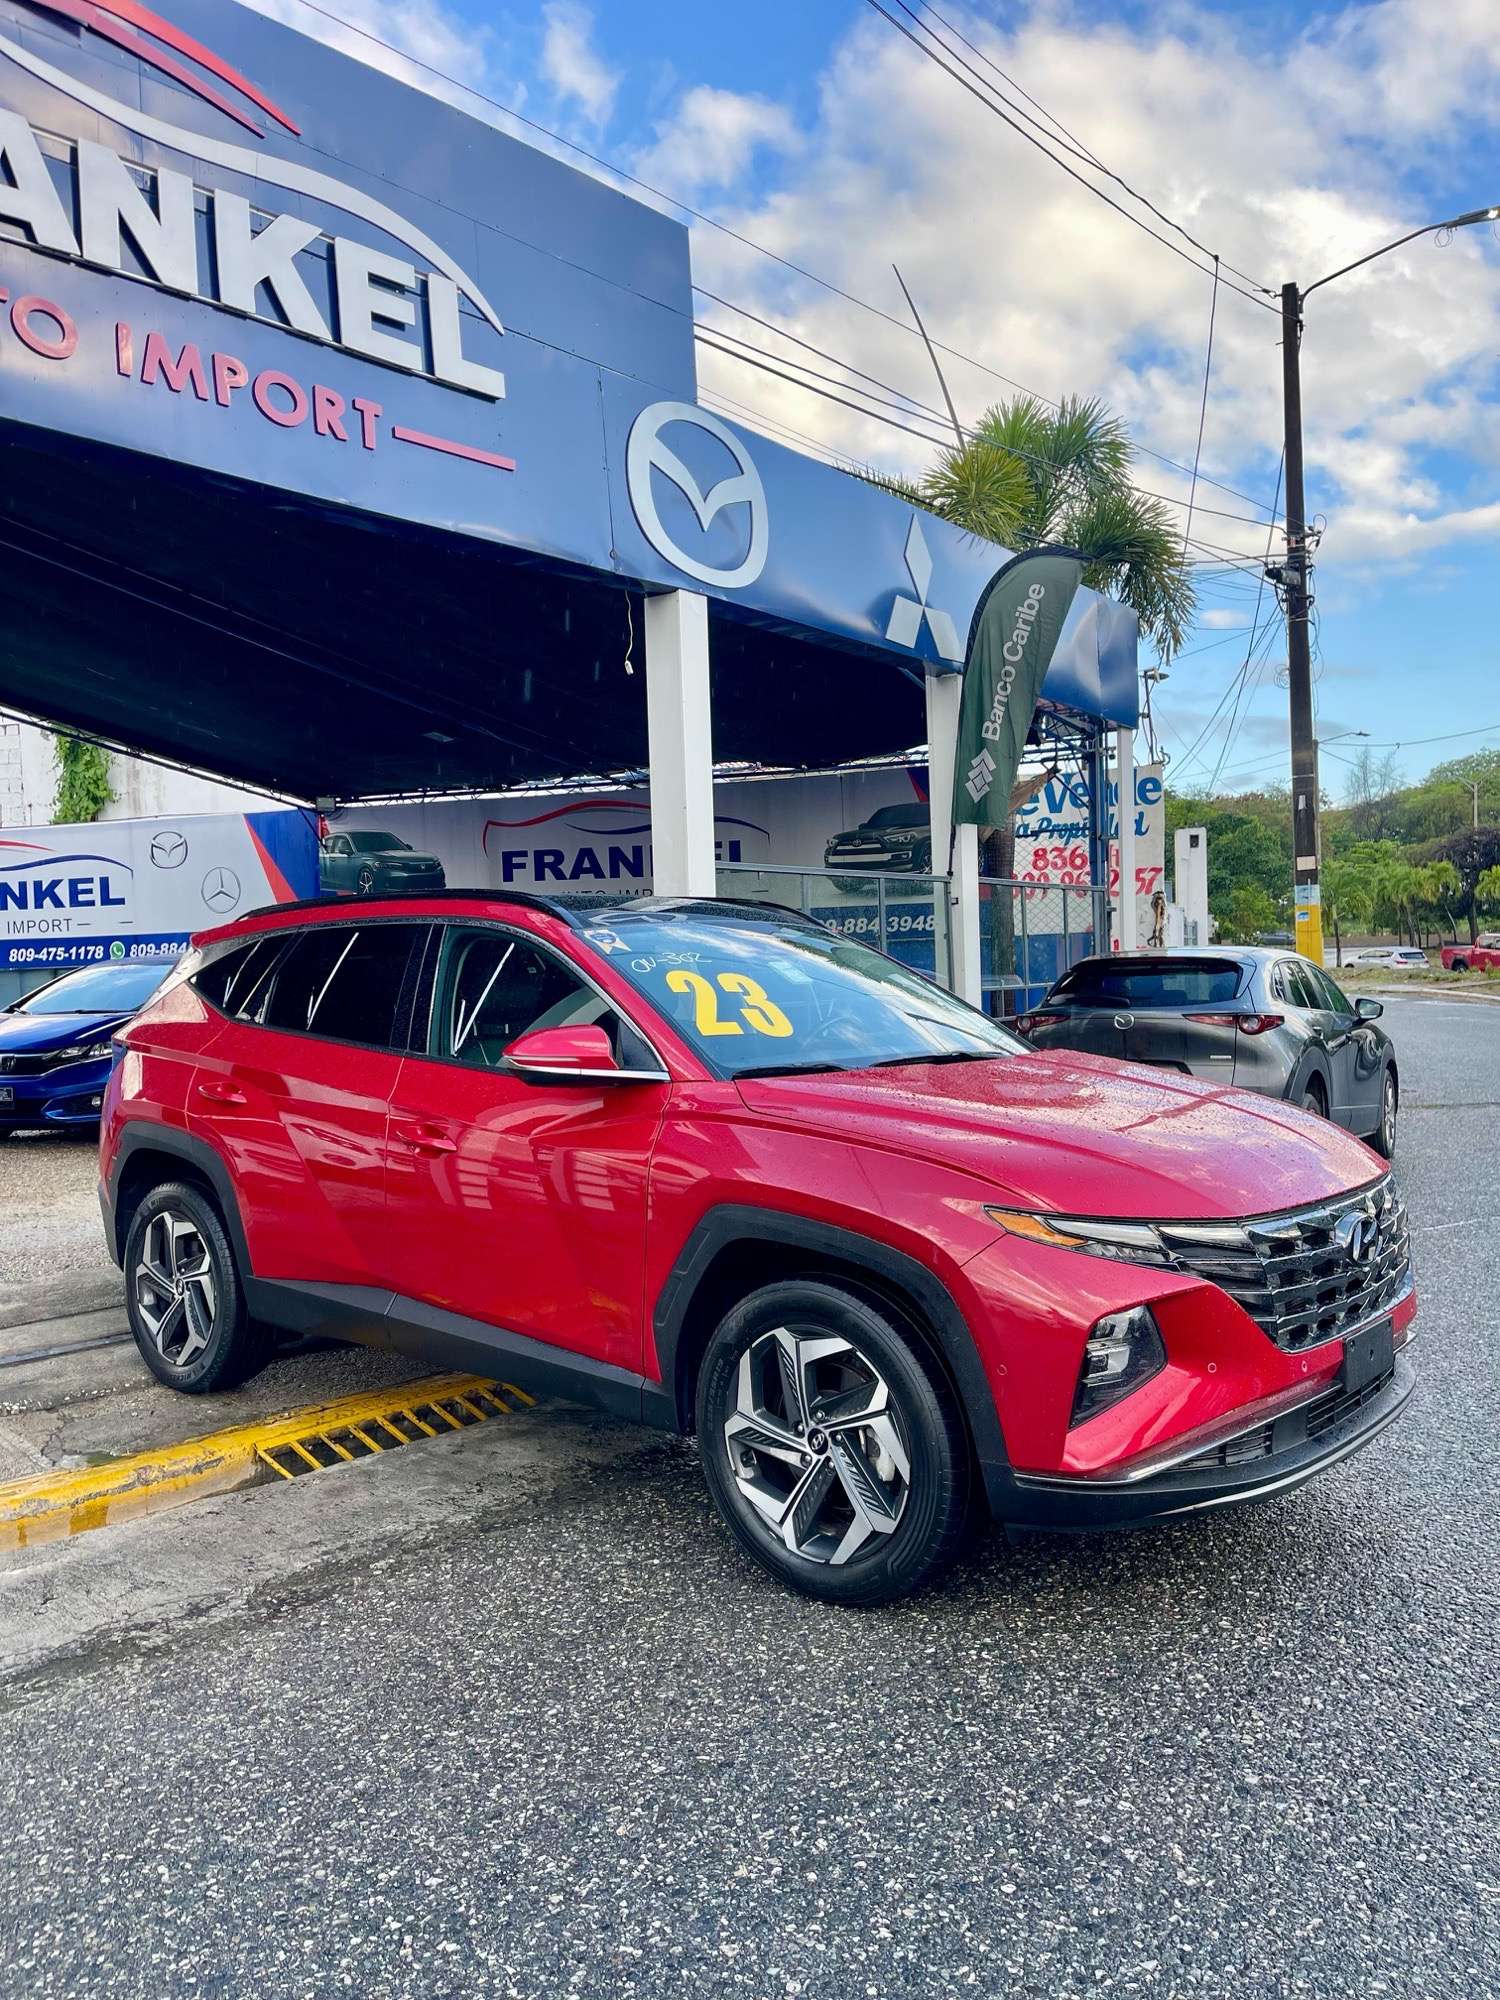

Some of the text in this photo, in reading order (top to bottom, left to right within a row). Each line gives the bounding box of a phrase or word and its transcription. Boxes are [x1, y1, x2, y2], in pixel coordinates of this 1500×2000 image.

[0, 288, 383, 450] O IMPORT
[981, 583, 1046, 742] Banco Caribe
[1032, 846, 1088, 871] 836
[7, 918, 73, 934] IMPORT
[9, 946, 104, 962] 809-475-1178
[666, 970, 794, 1037] 23
